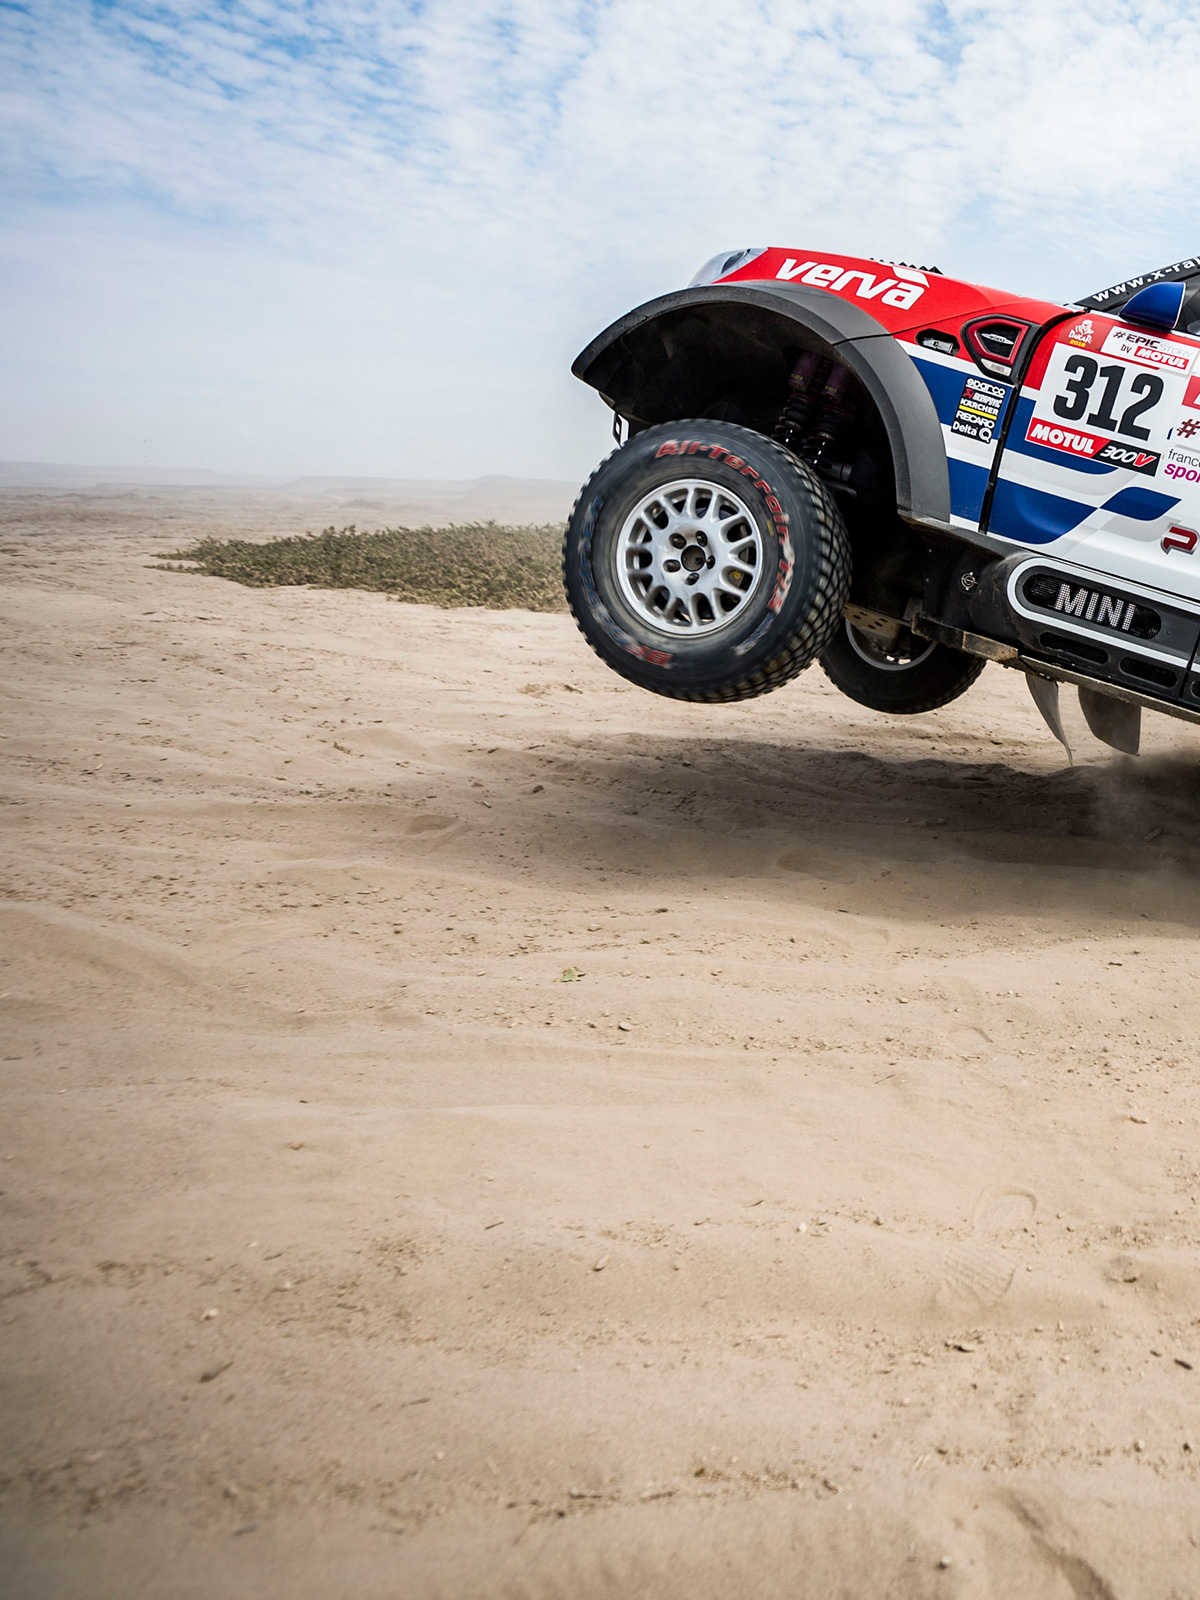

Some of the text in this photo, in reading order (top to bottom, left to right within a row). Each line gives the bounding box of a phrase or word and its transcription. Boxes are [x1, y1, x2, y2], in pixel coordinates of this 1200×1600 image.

[775, 258, 926, 311] verva
[1068, 328, 1093, 344] DAKAR
[1069, 339, 1086, 348] 2018
[1120, 344, 1186, 368] by MOTUL
[966, 378, 1006, 396] sparco
[1053, 354, 1165, 442] 312
[952, 421, 978, 436] Delta
[956, 410, 995, 429] RECARO
[1030, 424, 1158, 468] MOTUL 300V
[1054, 583, 1136, 631] MINI
